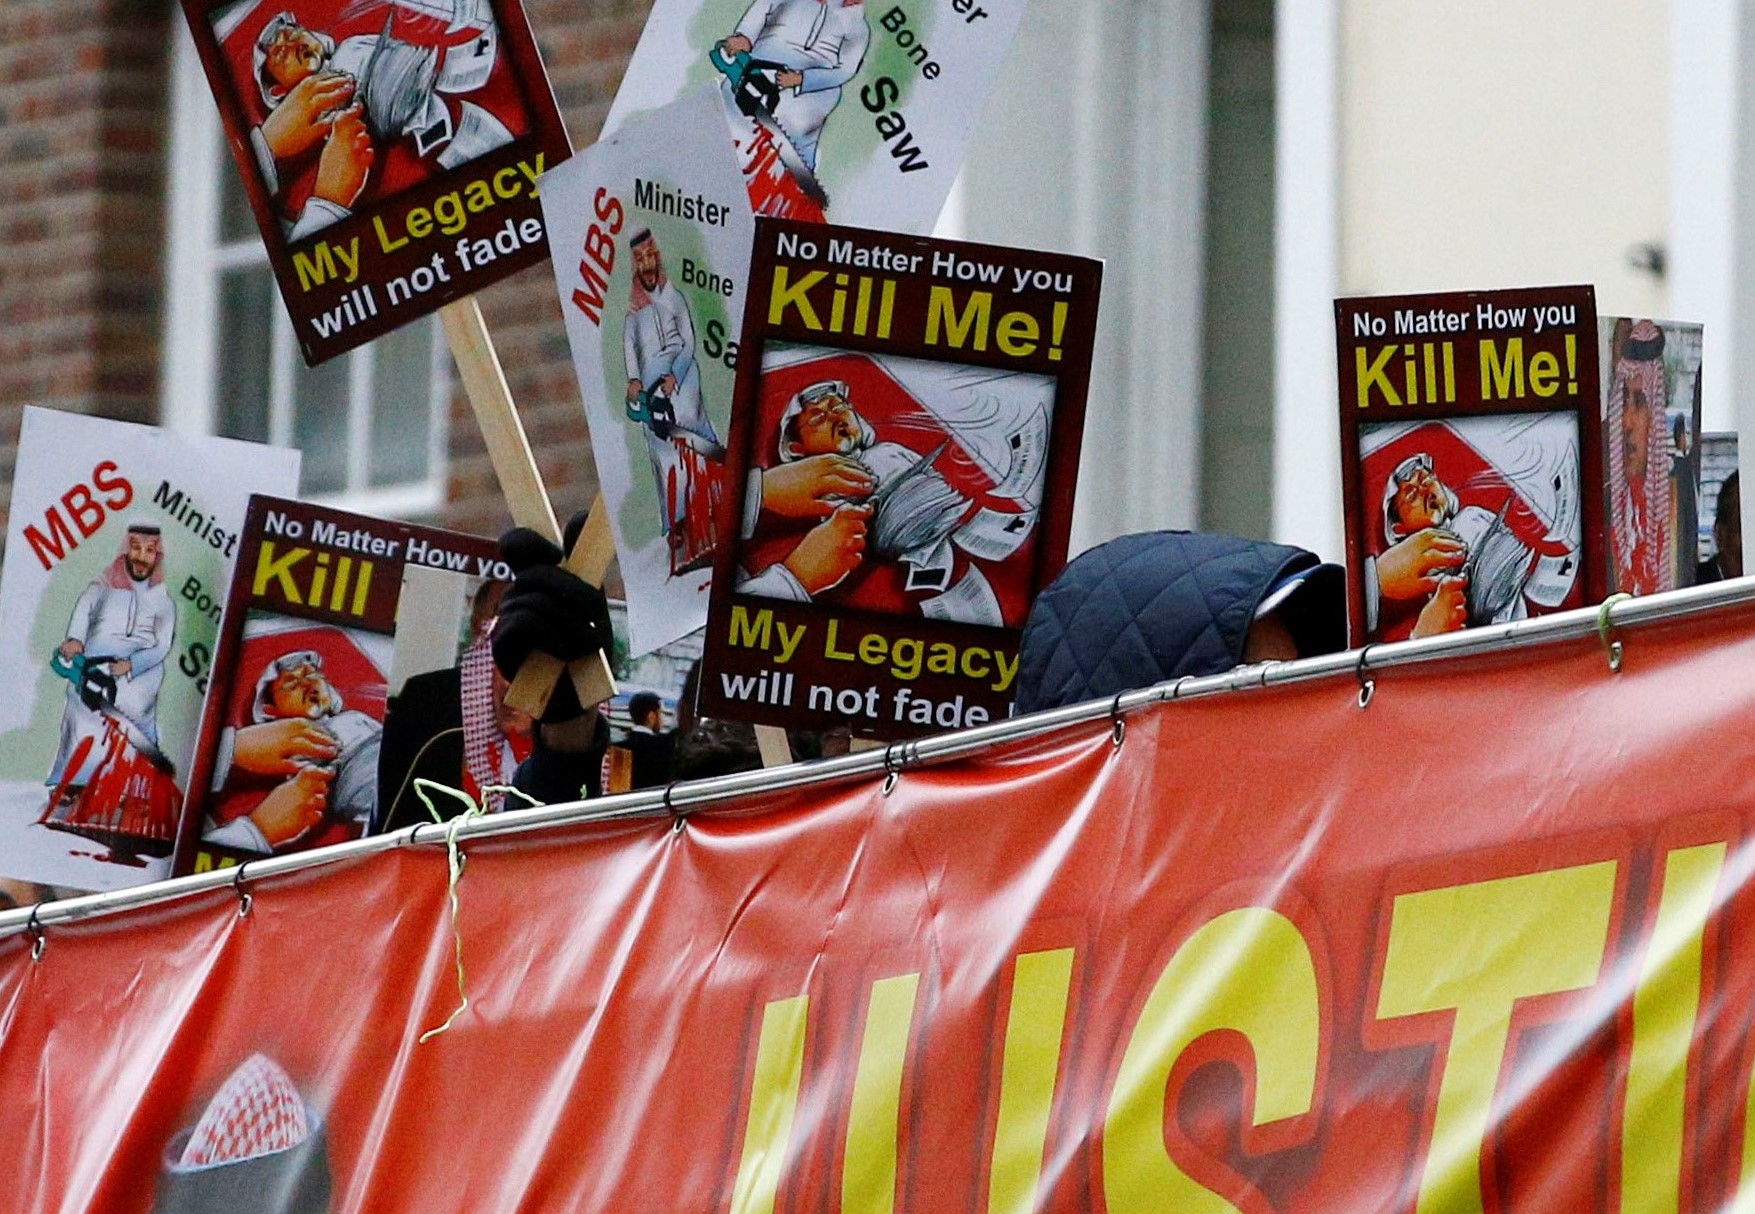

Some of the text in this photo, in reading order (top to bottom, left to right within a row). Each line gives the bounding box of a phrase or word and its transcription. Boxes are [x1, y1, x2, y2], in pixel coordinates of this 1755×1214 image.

[880, 5, 940, 80] Bone
[860, 76, 929, 173] Saw
[291, 152, 545, 292] My Legacy
[634, 177, 731, 228] Minister
[310, 217, 543, 339] will not fade
[572, 186, 625, 328] MBS
[681, 258, 734, 297] Bone
[776, 232, 1074, 294] No Matter How you
[767, 265, 1069, 362] Kill Me!
[1353, 303, 1577, 337] No Matter How you
[1355, 334, 1579, 408] Kill Me!
[23, 460, 134, 572] MBS
[153, 480, 237, 558] Minist
[264, 510, 517, 582] No Matter How yo
[252, 540, 375, 617] Kill
[728, 605, 1020, 692] My Legacy
[720, 670, 794, 707] will
[808, 684, 881, 718] not
[893, 688, 990, 729] fade
